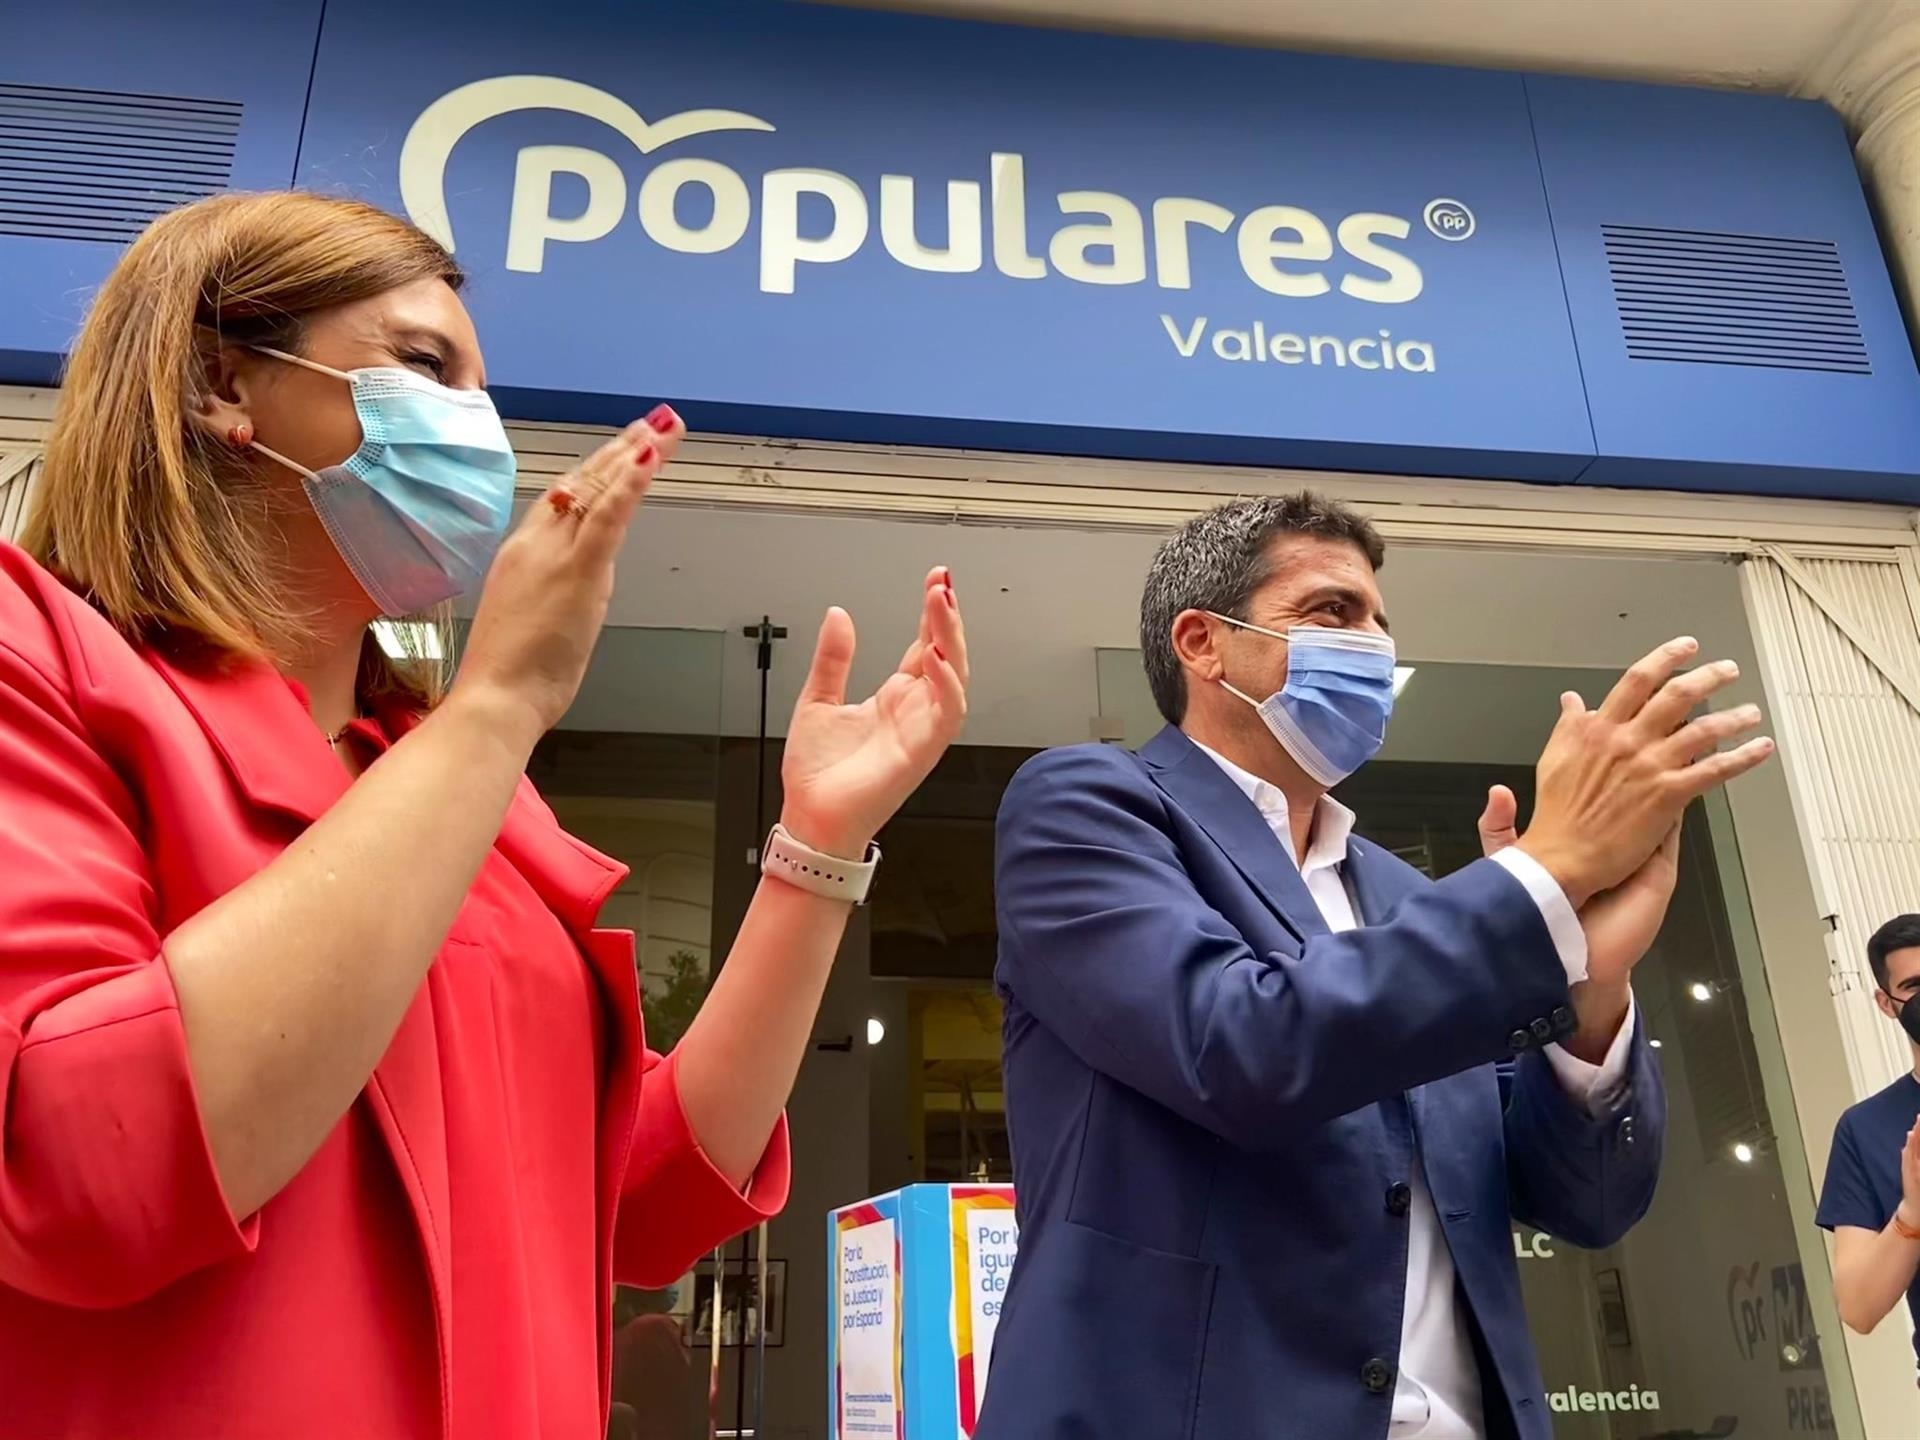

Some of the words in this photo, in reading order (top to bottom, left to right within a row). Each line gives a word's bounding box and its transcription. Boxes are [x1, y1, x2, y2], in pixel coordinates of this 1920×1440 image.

[1159, 314, 1436, 373] Valencia
[978, 1226, 1010, 1245] Por
[844, 1246, 856, 1262] Por
[981, 1272, 1006, 1292] de
[851, 1286, 878, 1305] Justicia
[878, 1287, 883, 1308] y
[843, 1314, 855, 1334] por
[856, 1308, 883, 1334] España
[1545, 1383, 1660, 1412] alencia
